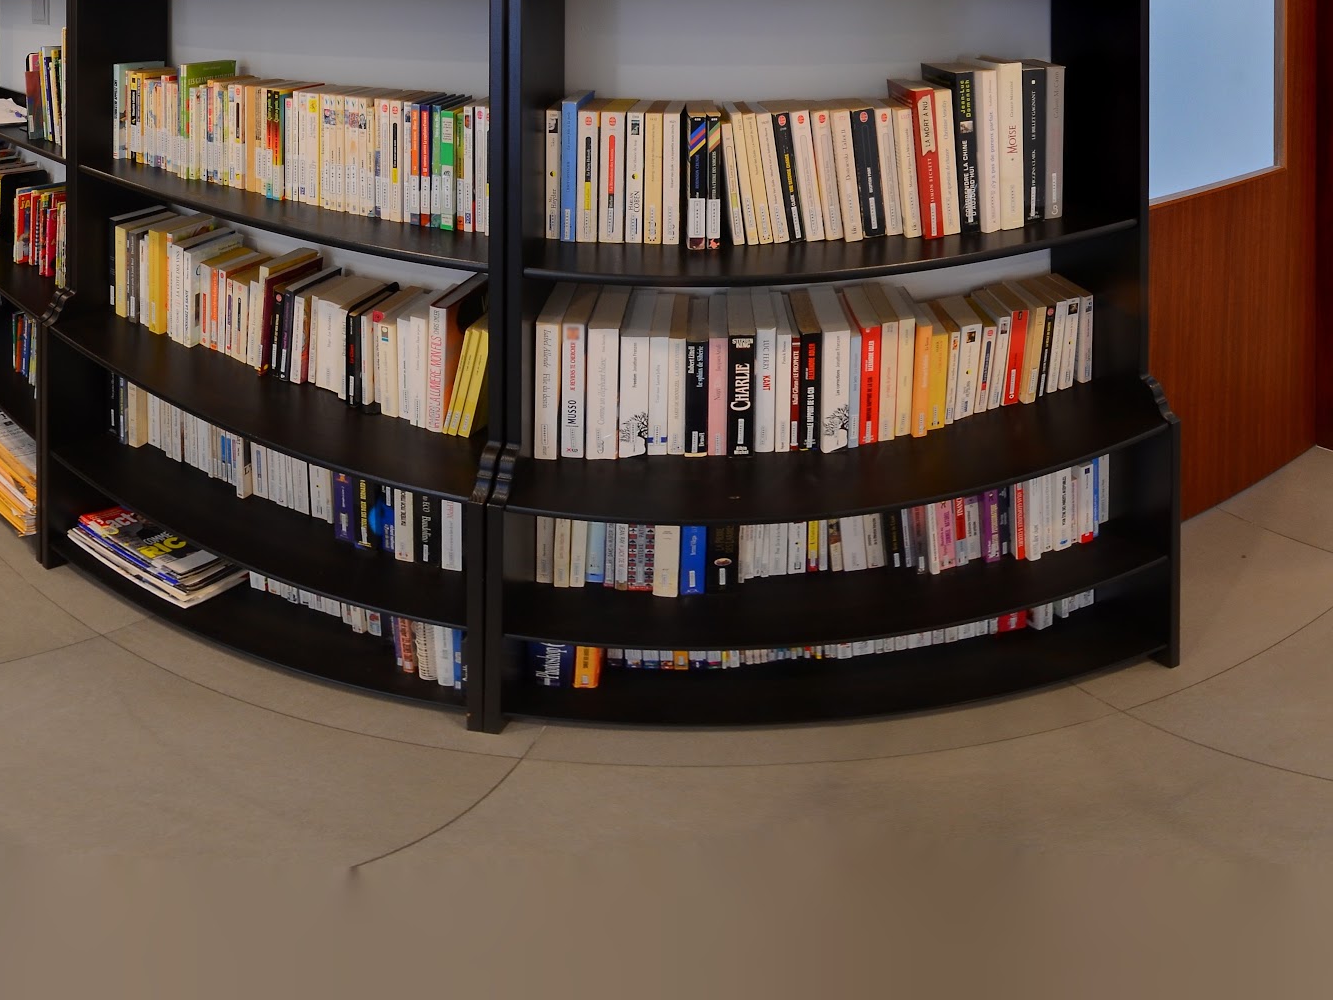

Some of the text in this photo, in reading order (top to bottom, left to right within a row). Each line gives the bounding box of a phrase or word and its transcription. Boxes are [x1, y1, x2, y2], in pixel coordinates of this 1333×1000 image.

[924, 139, 930, 147] LA
[431, 337, 442, 350] FILS
[431, 351, 441, 367] MON
[763, 375, 771, 390] KANT
[568, 400, 576, 424] MUSSO
[421, 502, 431, 542] ECO Baudolino
